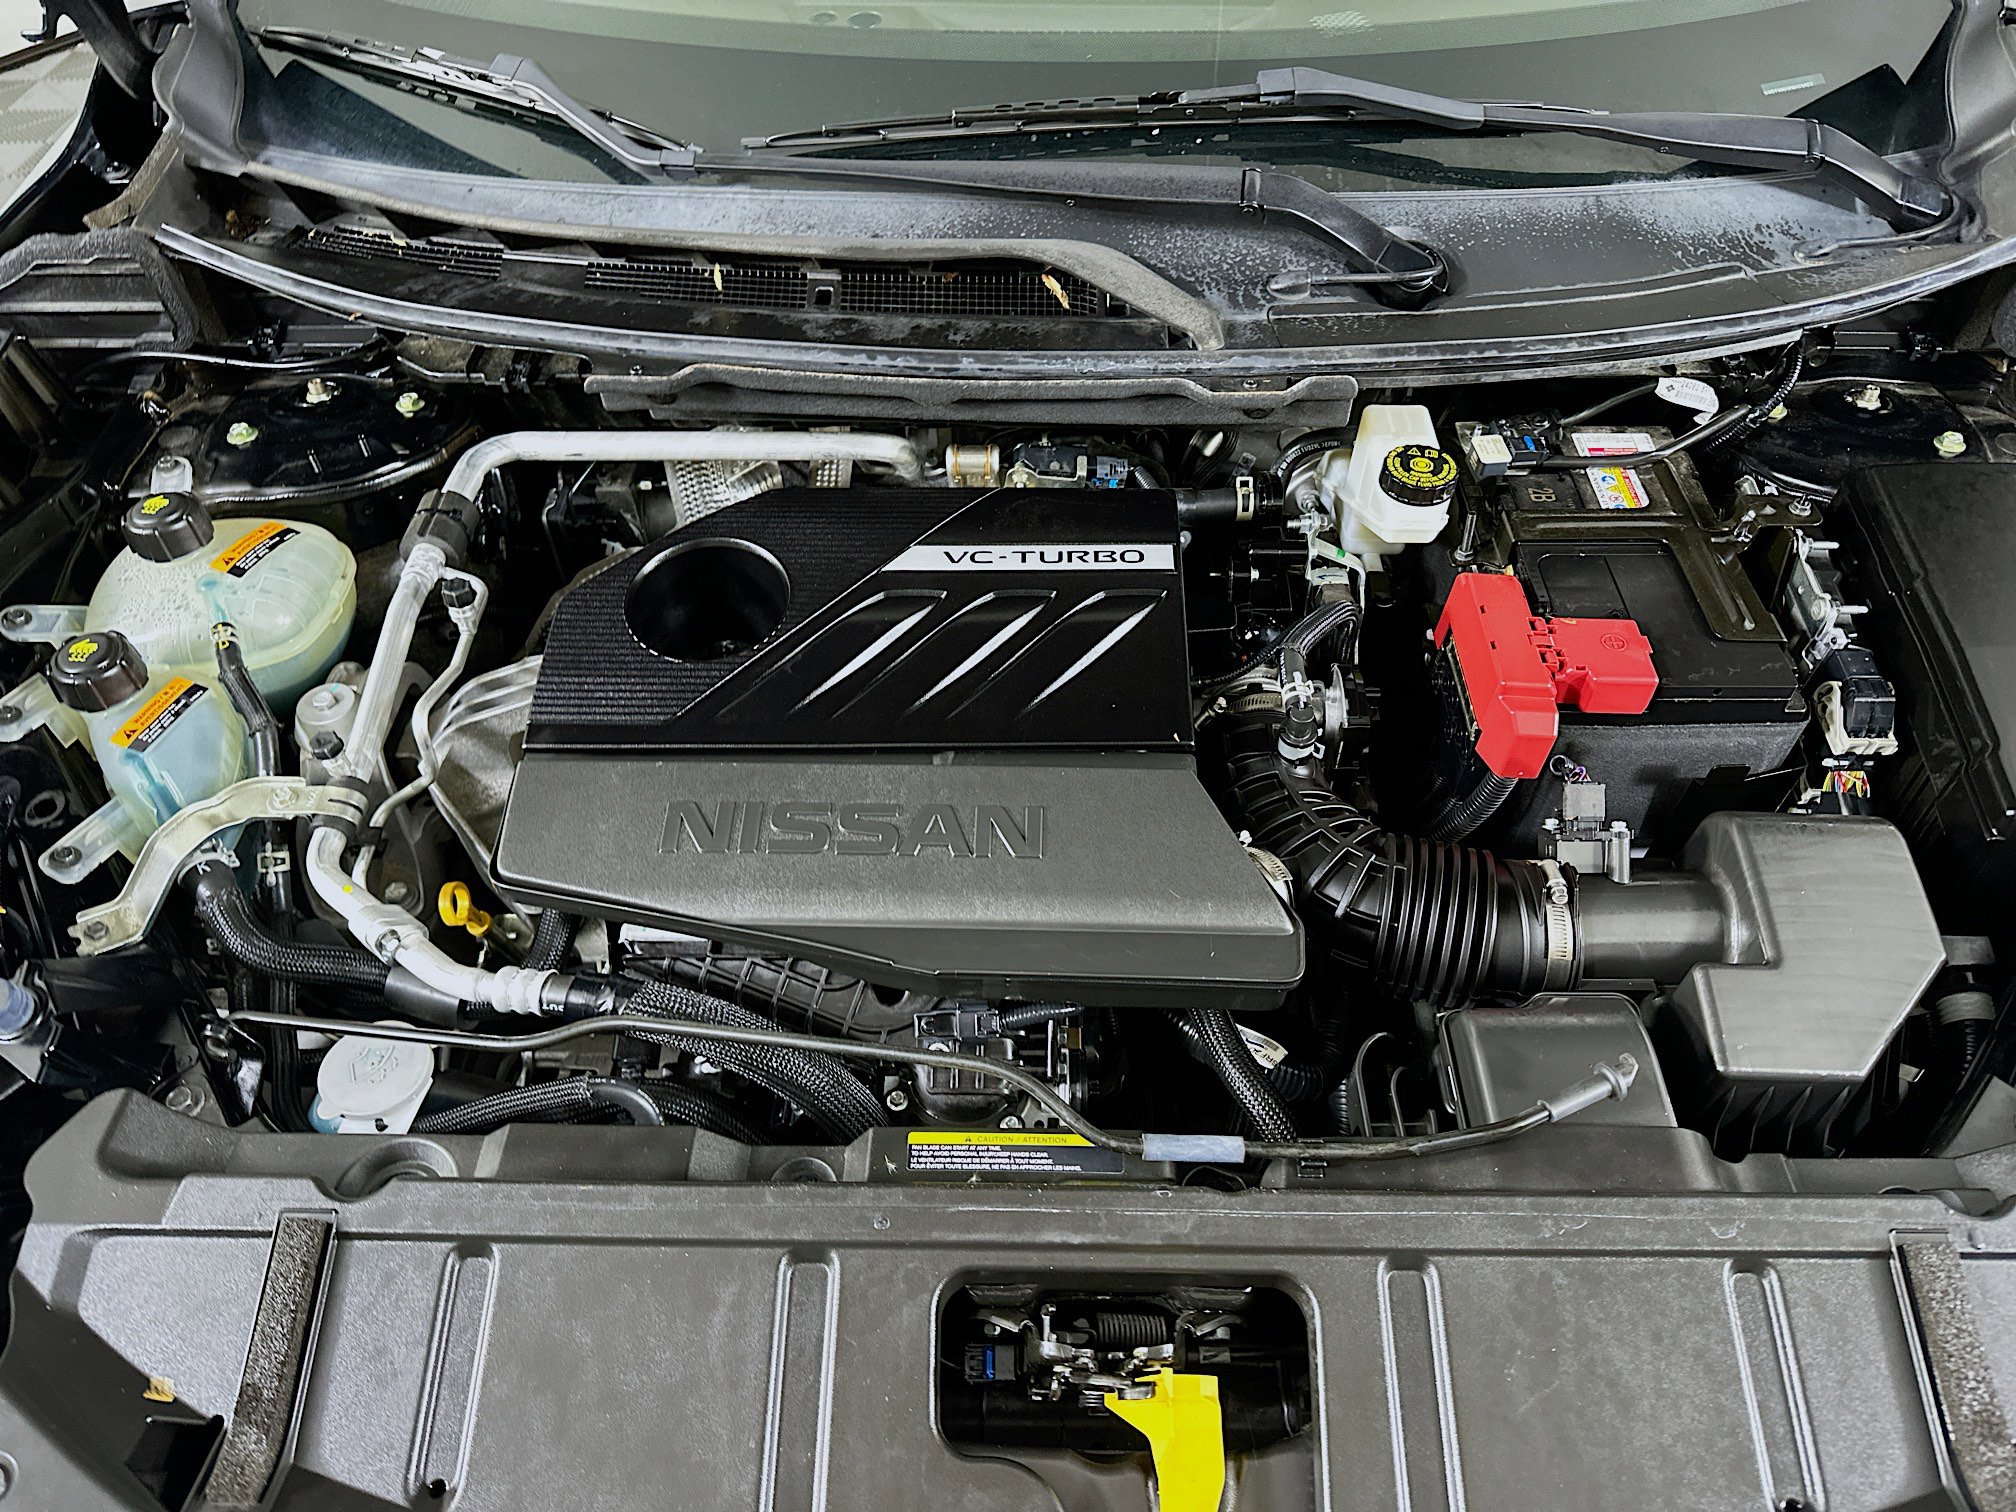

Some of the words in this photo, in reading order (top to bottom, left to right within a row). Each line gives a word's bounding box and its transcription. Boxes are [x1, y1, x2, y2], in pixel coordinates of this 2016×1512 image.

[1528, 487, 1557, 502] 2B
[943, 549, 1145, 564] VC-TURBO
[658, 800, 1045, 859] NISSAN
[977, 1135, 1014, 1144] CAUTION
[1023, 1136, 1067, 1144] ATTENTION
